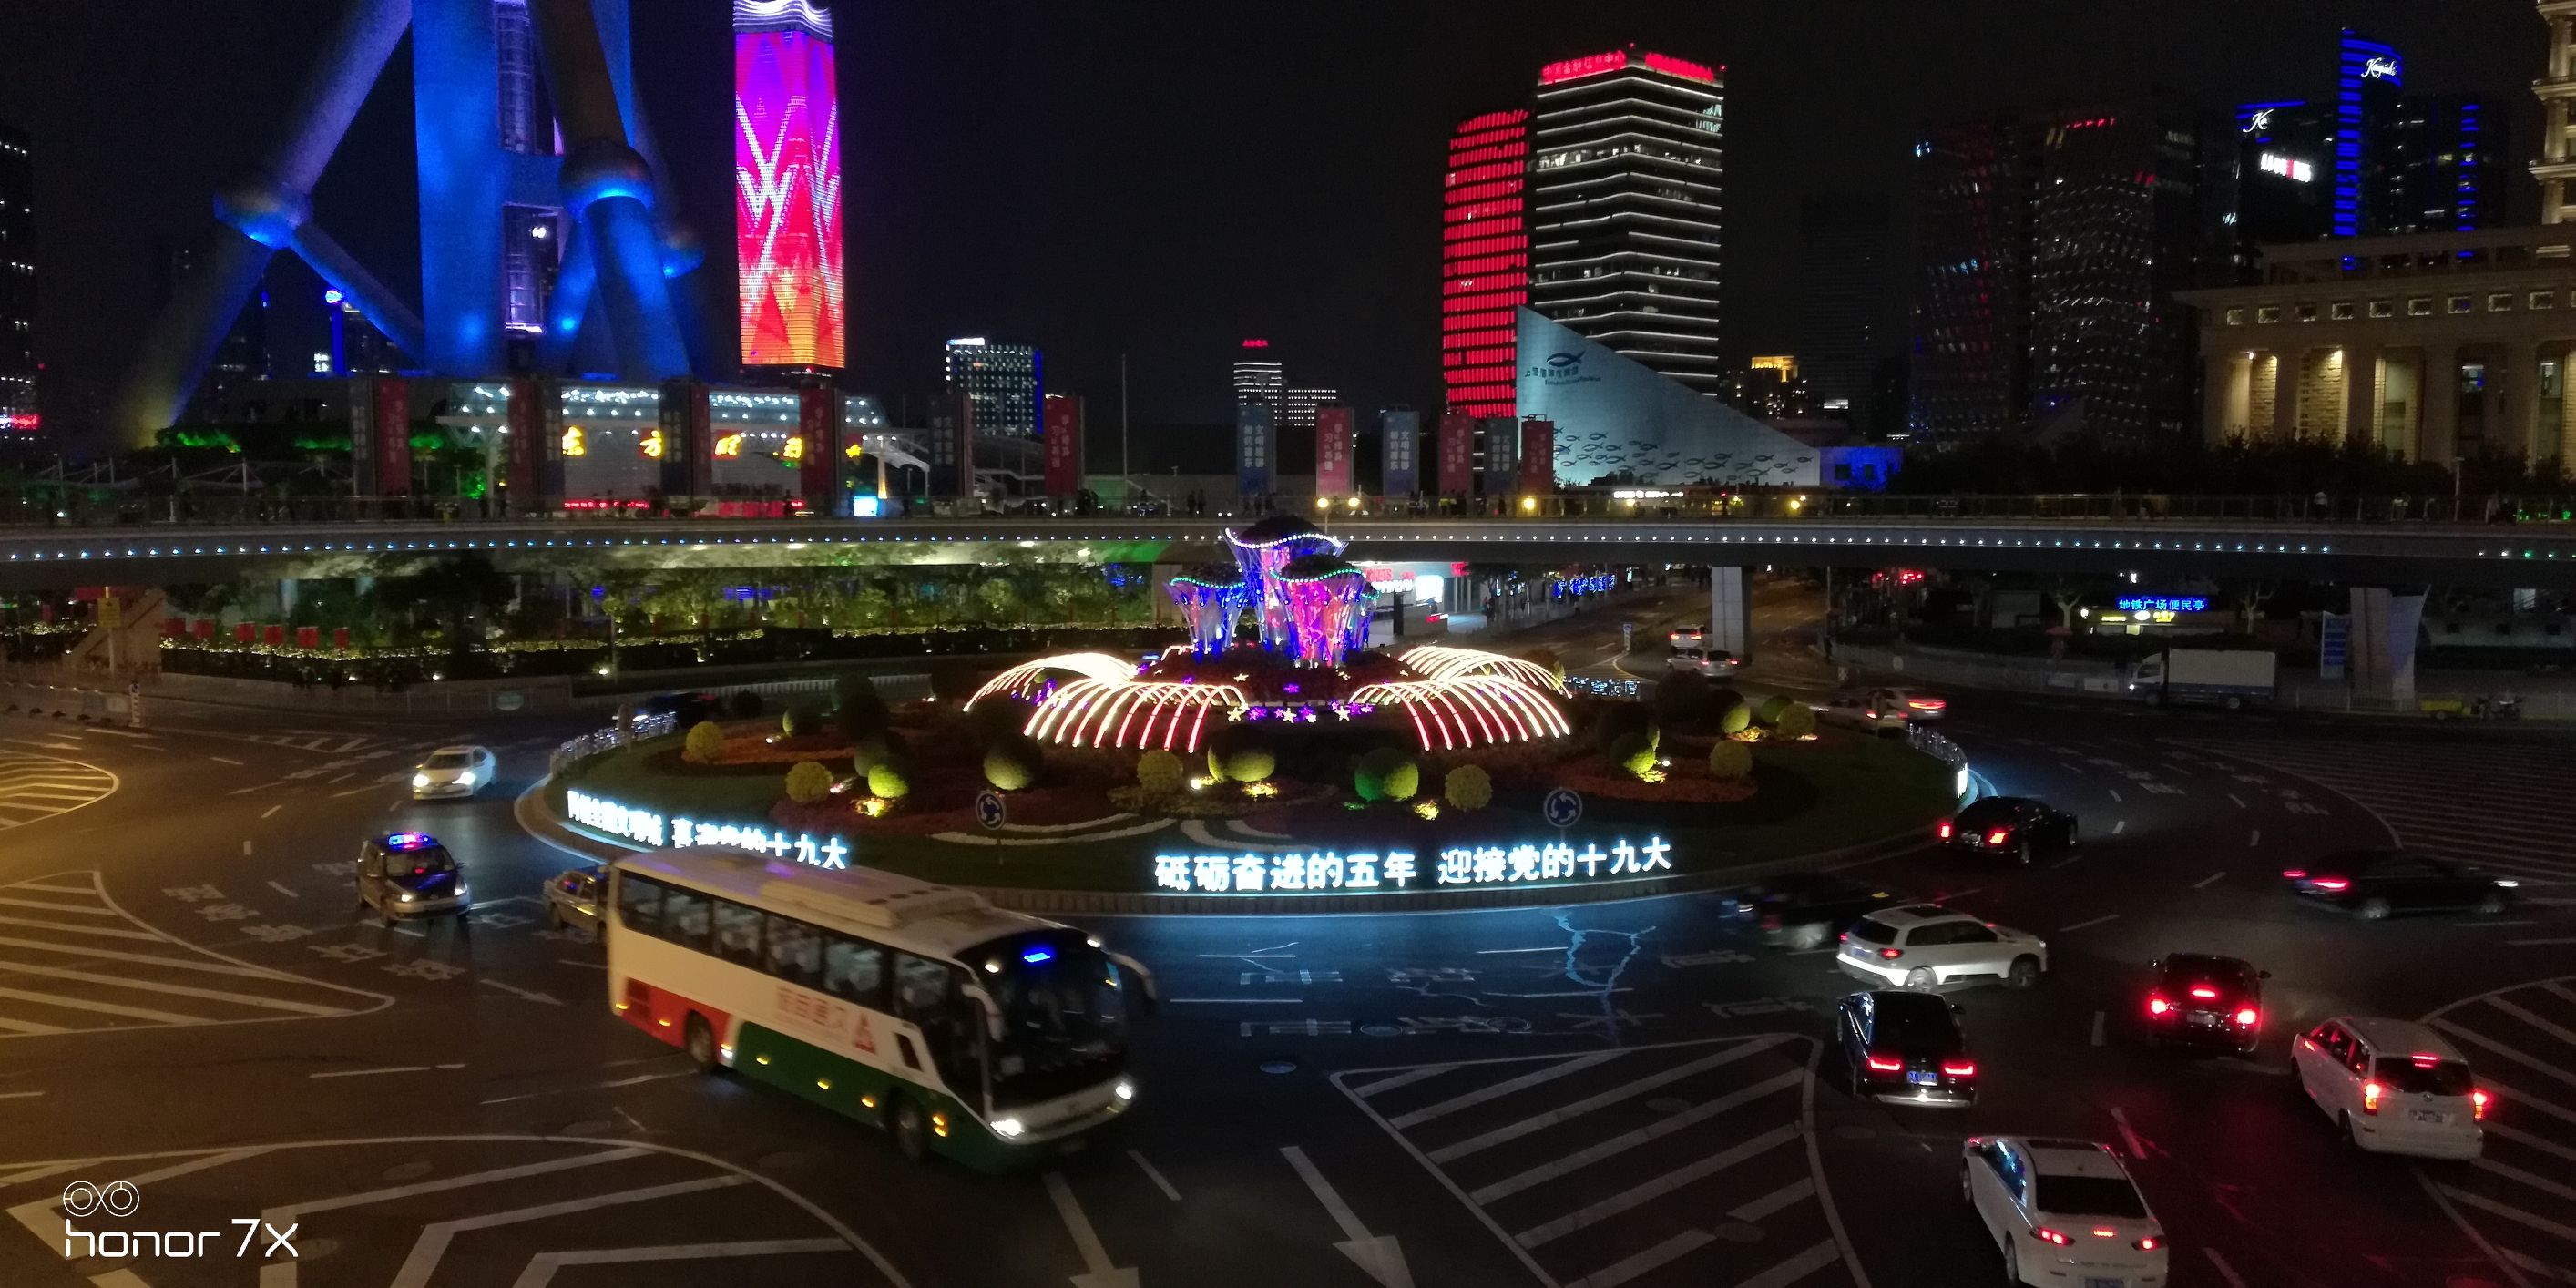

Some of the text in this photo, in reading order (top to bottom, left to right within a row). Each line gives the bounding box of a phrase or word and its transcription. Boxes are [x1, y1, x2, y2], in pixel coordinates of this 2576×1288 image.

[2118, 599, 2205, 611] 地铁广场便民亭
[1154, 836, 1672, 893] 砥砺奋进的五年 迎接党的十九大
